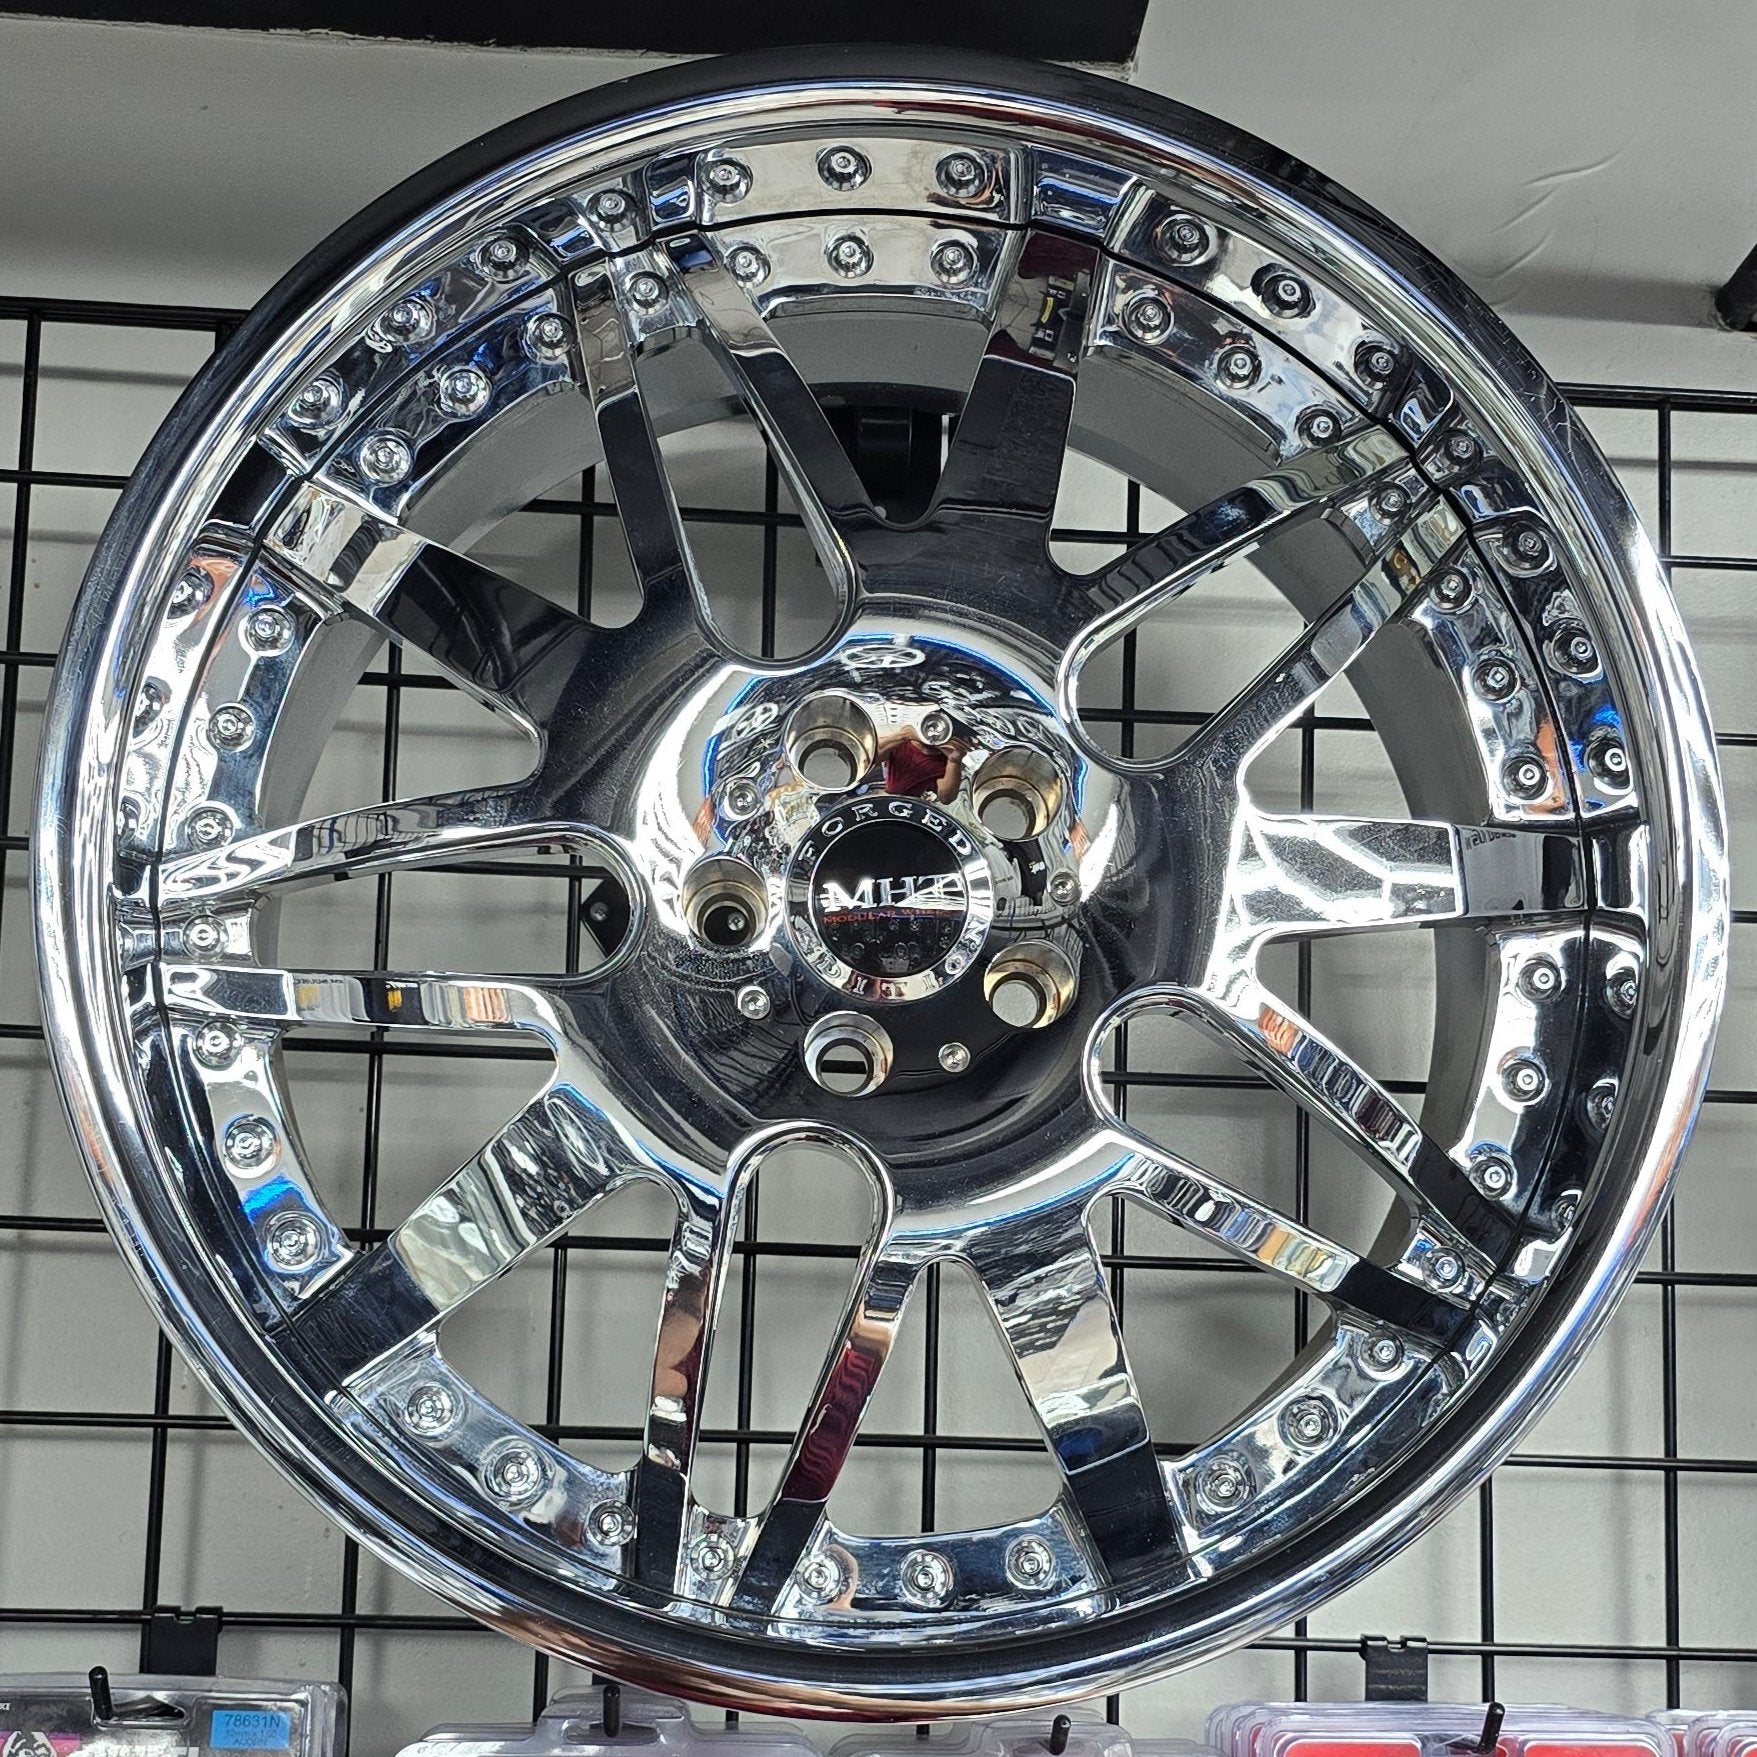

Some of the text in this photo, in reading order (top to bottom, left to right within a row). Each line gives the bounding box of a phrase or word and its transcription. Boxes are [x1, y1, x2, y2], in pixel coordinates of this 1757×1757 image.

[798, 801, 973, 863] FORGED
[823, 911, 896, 924] MODULAR
[224, 1713, 280, 1729] 78631N
